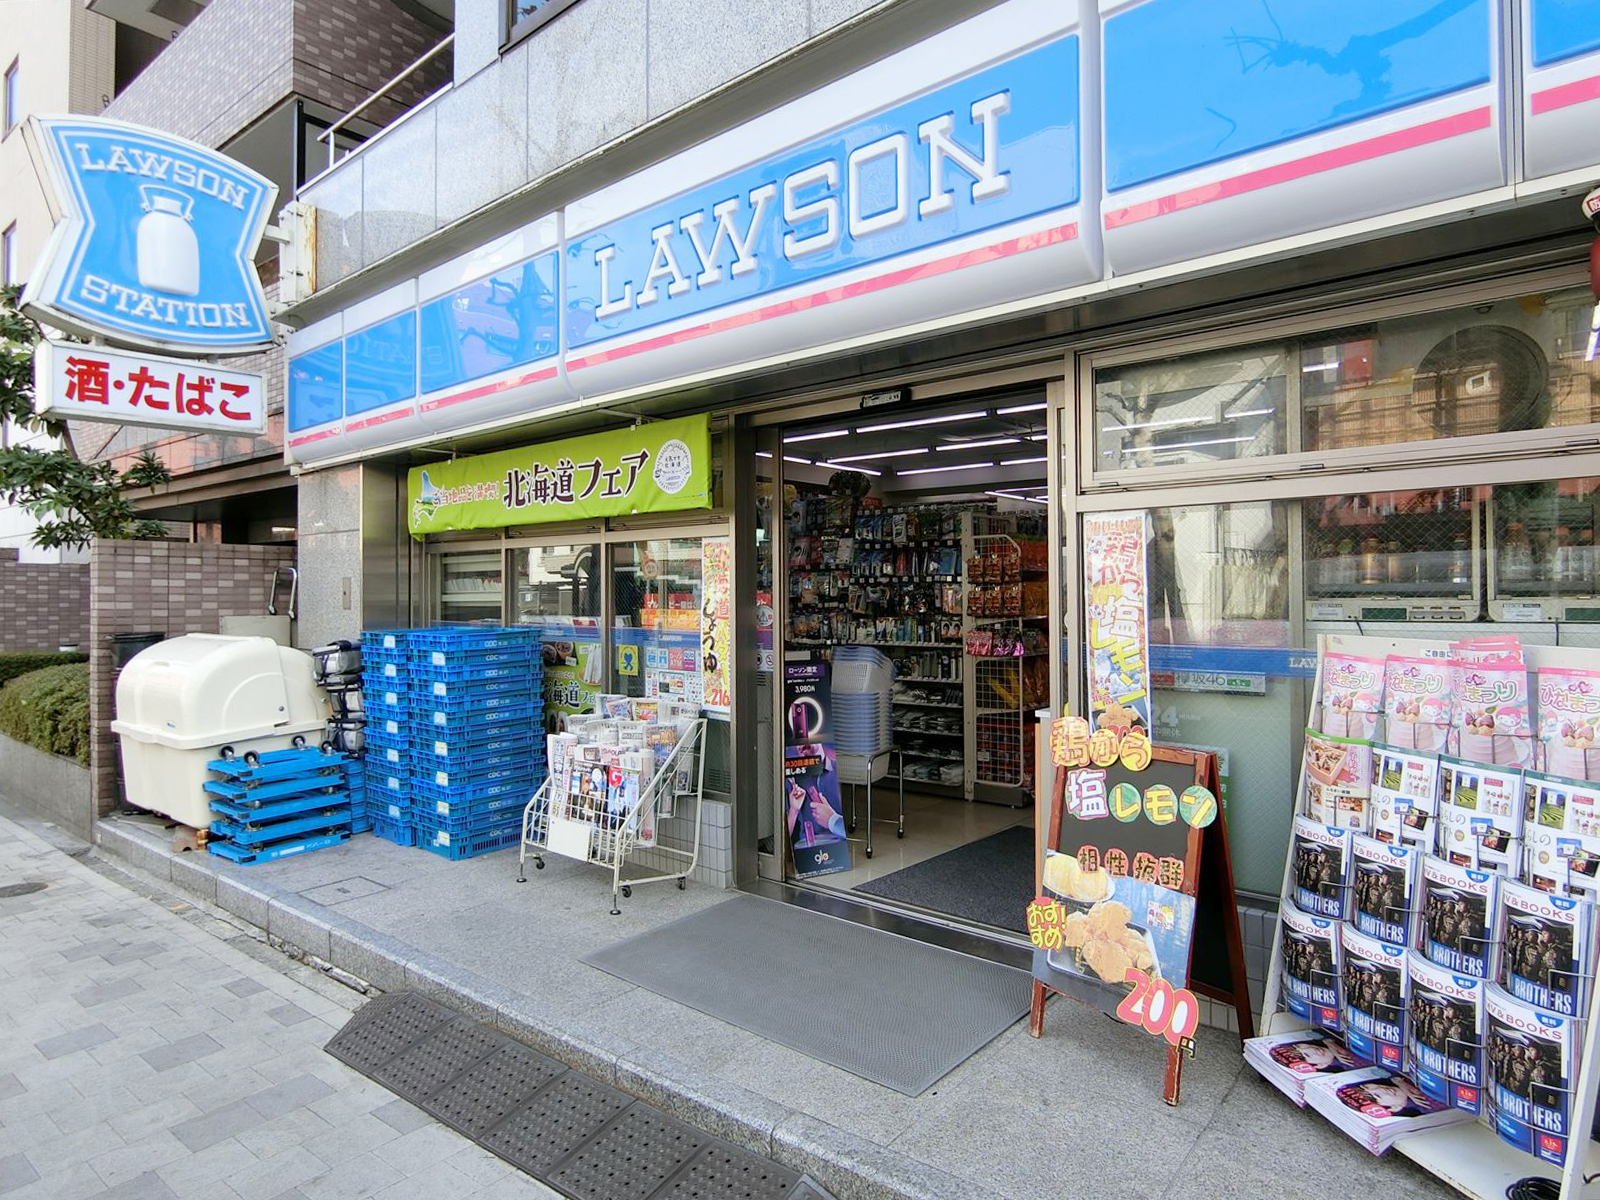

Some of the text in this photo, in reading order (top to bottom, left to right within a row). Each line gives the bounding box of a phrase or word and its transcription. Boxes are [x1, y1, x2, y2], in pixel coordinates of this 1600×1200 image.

[74, 142, 250, 210] LAWSON
[596, 88, 1011, 321] LAWSON
[80, 274, 251, 328] STATION
[503, 448, 649, 509] 北海道フェア
[1051, 718, 1151, 770] 鶏から
[1068, 770, 1213, 828] 塩レモン
[1078, 846, 1184, 888] 相性抜群
[1116, 967, 1199, 1046] 200
